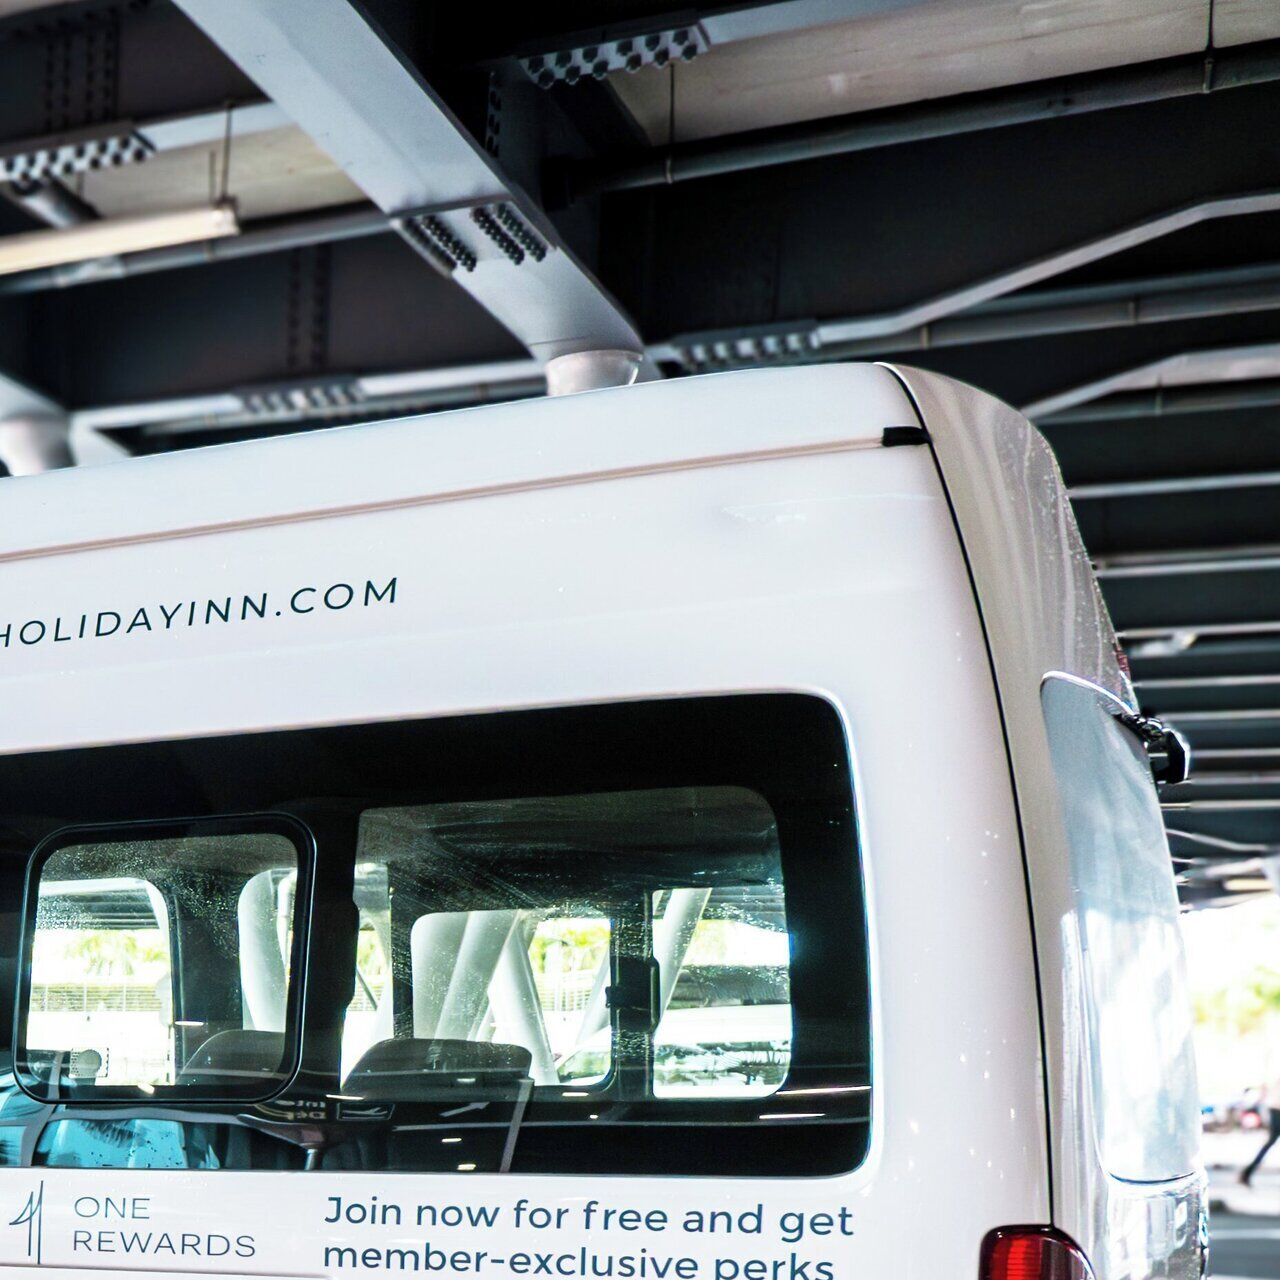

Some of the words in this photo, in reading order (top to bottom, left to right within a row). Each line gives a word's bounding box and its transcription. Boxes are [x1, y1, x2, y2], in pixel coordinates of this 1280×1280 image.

[73, 1196, 151, 1220] ONE
[323, 1195, 402, 1226] Join
[415, 1204, 501, 1228] now
[513, 1199, 570, 1230] for
[582, 1200, 669, 1232] free
[682, 1203, 764, 1234] and
[778, 1206, 855, 1243] get
[72, 1230, 257, 1258] REWARDS
[323, 1242, 699, 1280] member-exclusive
